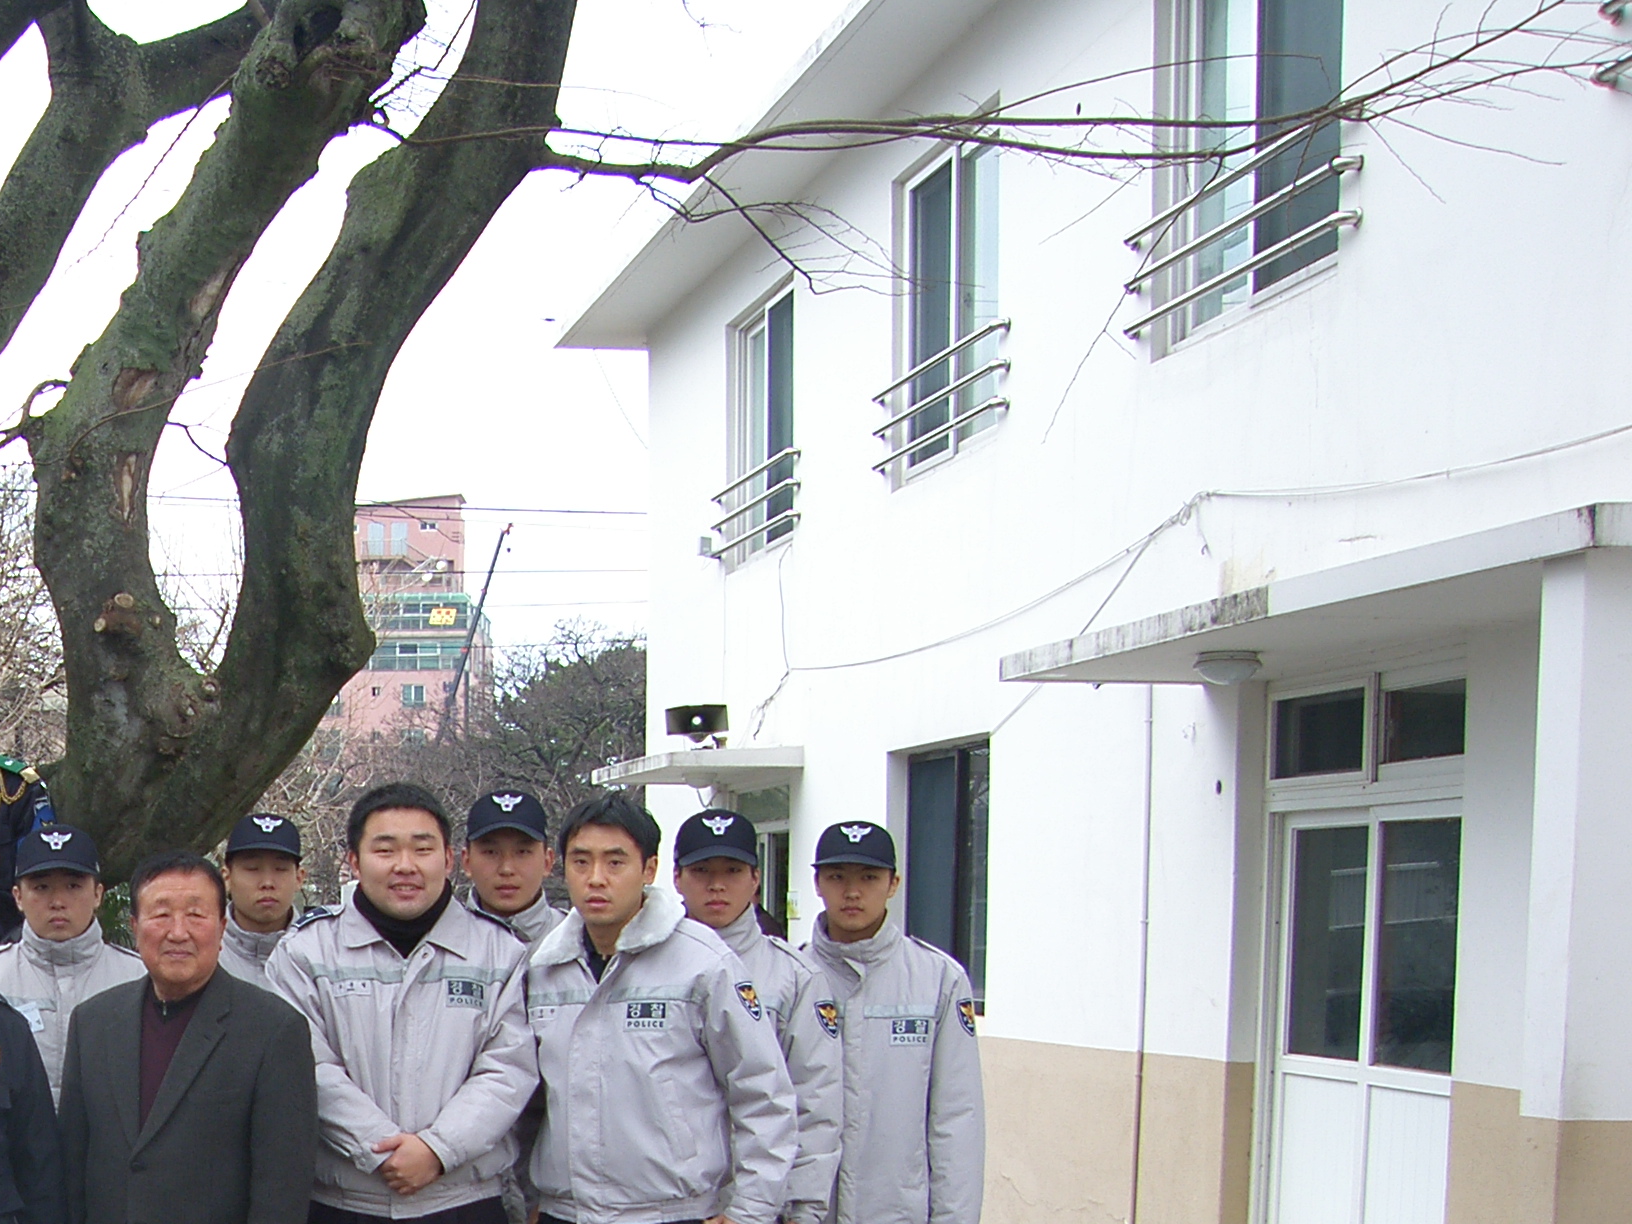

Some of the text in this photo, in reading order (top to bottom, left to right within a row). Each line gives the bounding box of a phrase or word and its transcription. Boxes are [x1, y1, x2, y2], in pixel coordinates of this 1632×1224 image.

[449, 997, 483, 1007] POLICE
[628, 1003, 665, 1018] 경찰
[627, 1020, 664, 1028] POLICE
[893, 1019, 927, 1034] 경찰
